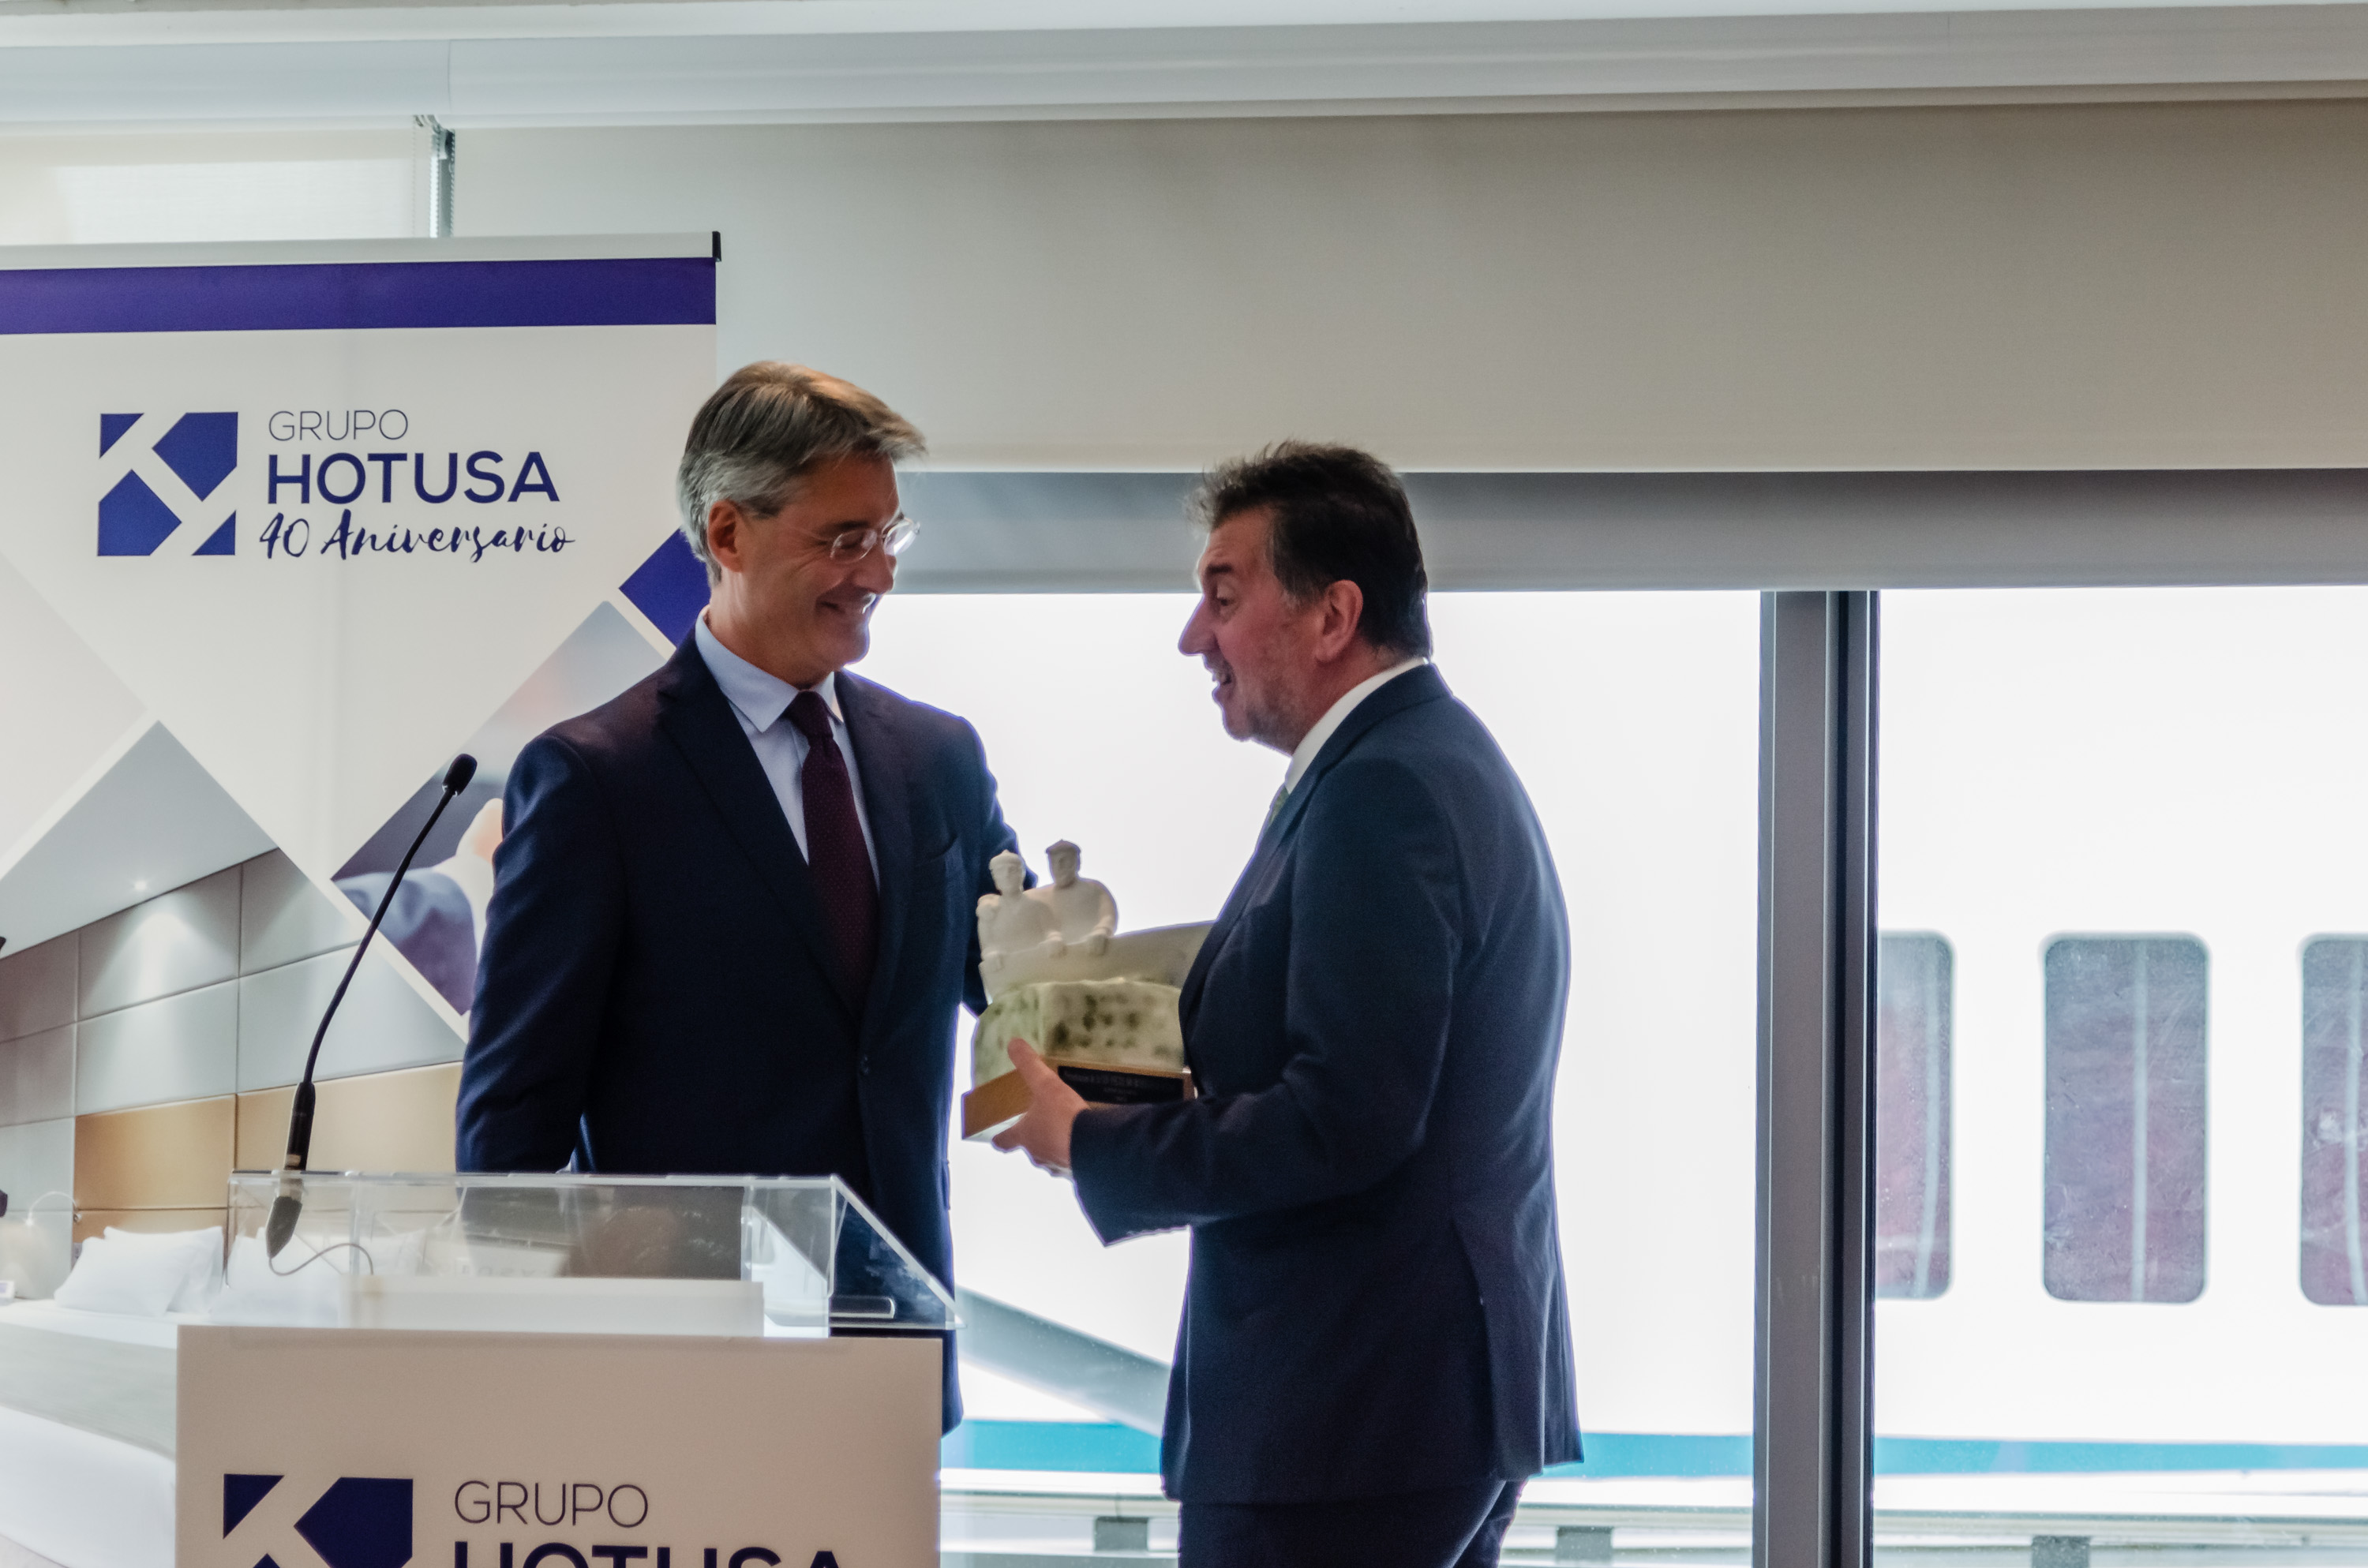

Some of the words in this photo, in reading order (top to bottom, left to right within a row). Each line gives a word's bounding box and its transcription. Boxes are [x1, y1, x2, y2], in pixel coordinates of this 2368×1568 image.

[268, 410, 408, 441] GRUPO
[268, 451, 560, 504] HOTUSA
[260, 512, 309, 559] 40
[320, 508, 576, 563] Aniversario
[455, 1480, 648, 1529] GRUPO
